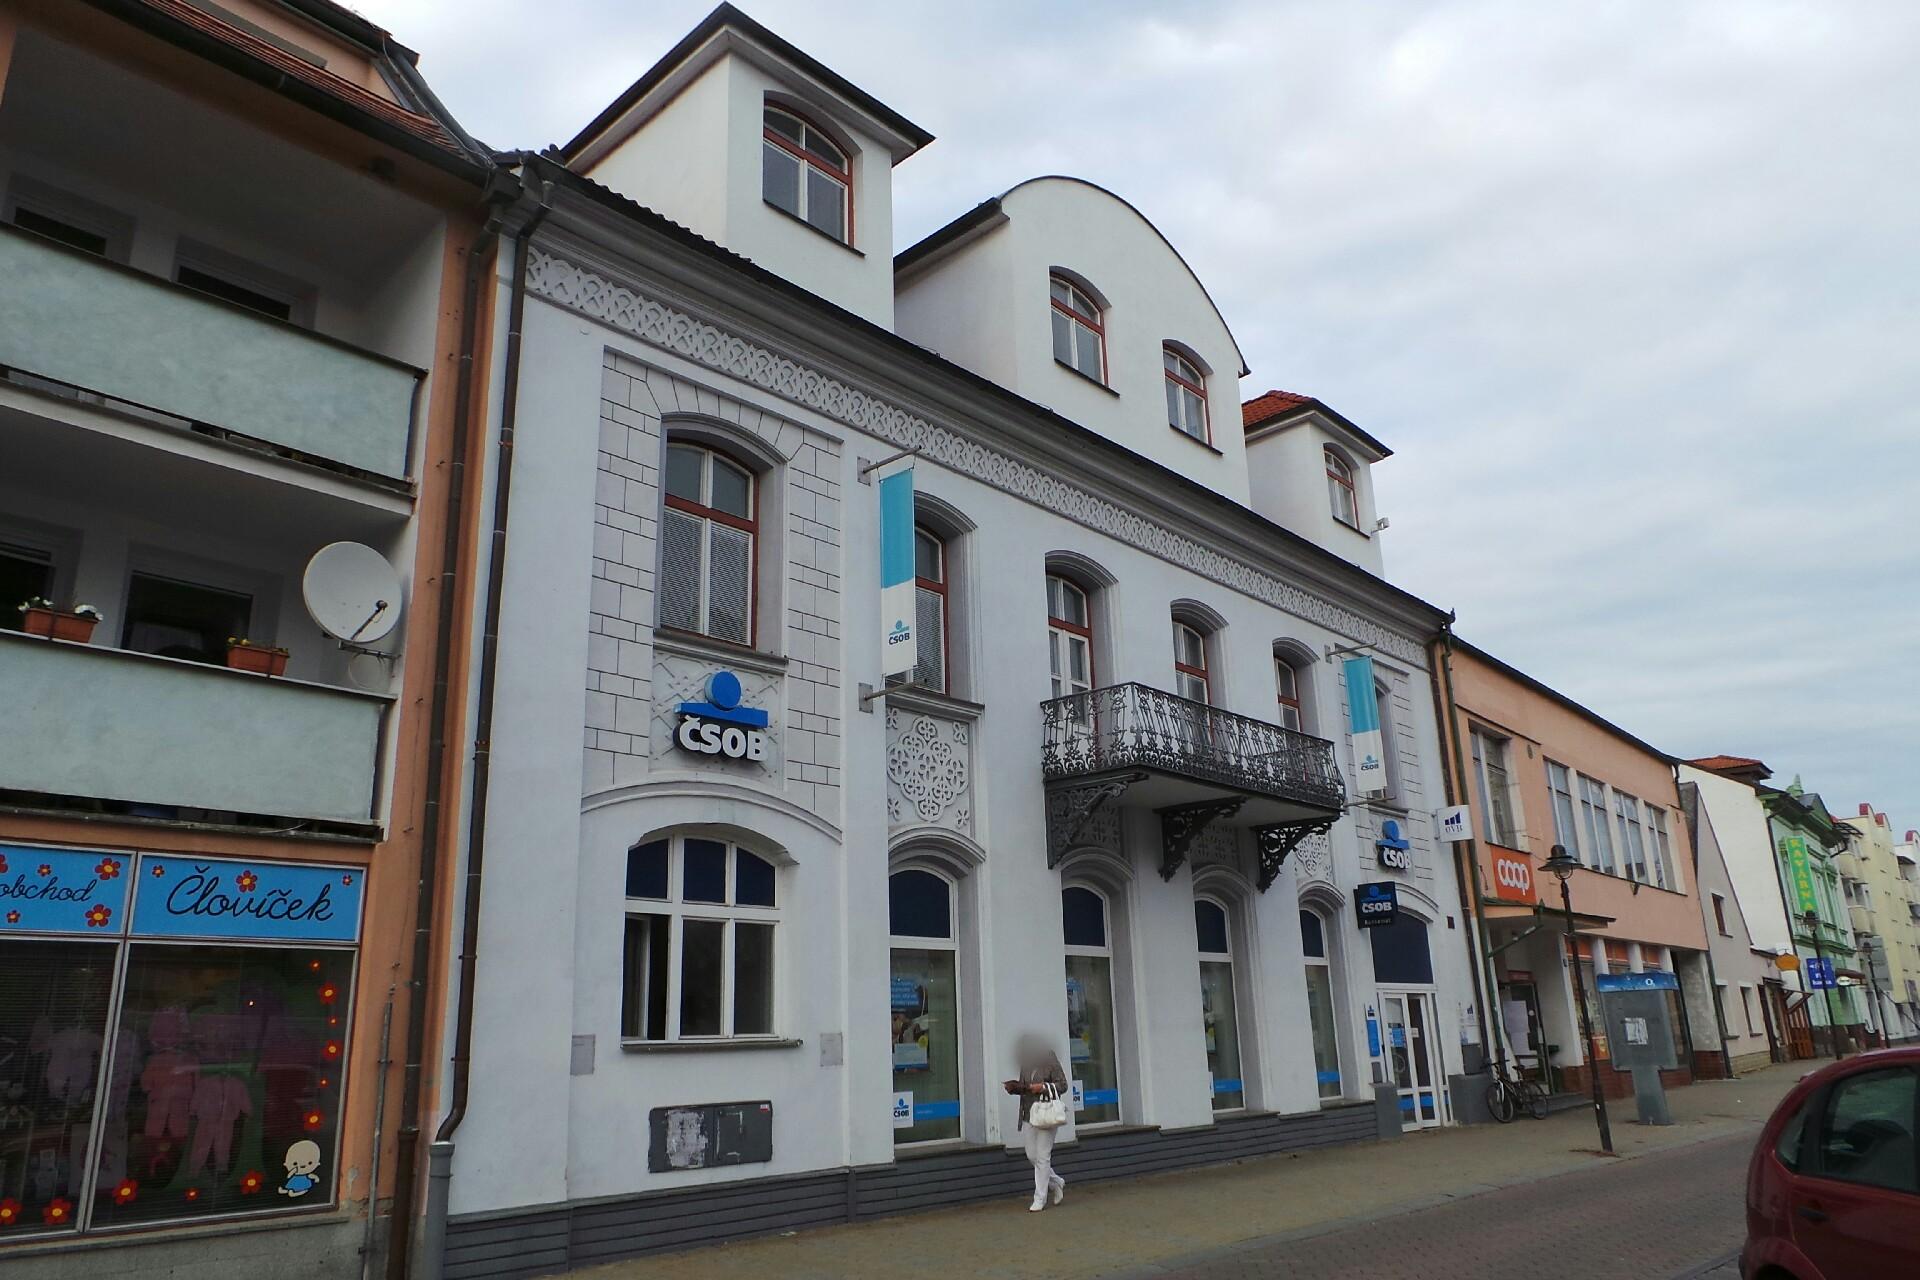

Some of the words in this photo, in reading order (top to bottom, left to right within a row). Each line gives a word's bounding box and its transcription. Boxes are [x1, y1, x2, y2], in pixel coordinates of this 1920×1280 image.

[679, 714, 768, 762] ČSOB
[1383, 846, 1411, 869] ČSOB
[0, 873, 98, 902] obchod
[166, 865, 334, 922] Človíček
[1498, 858, 1530, 896] coop
